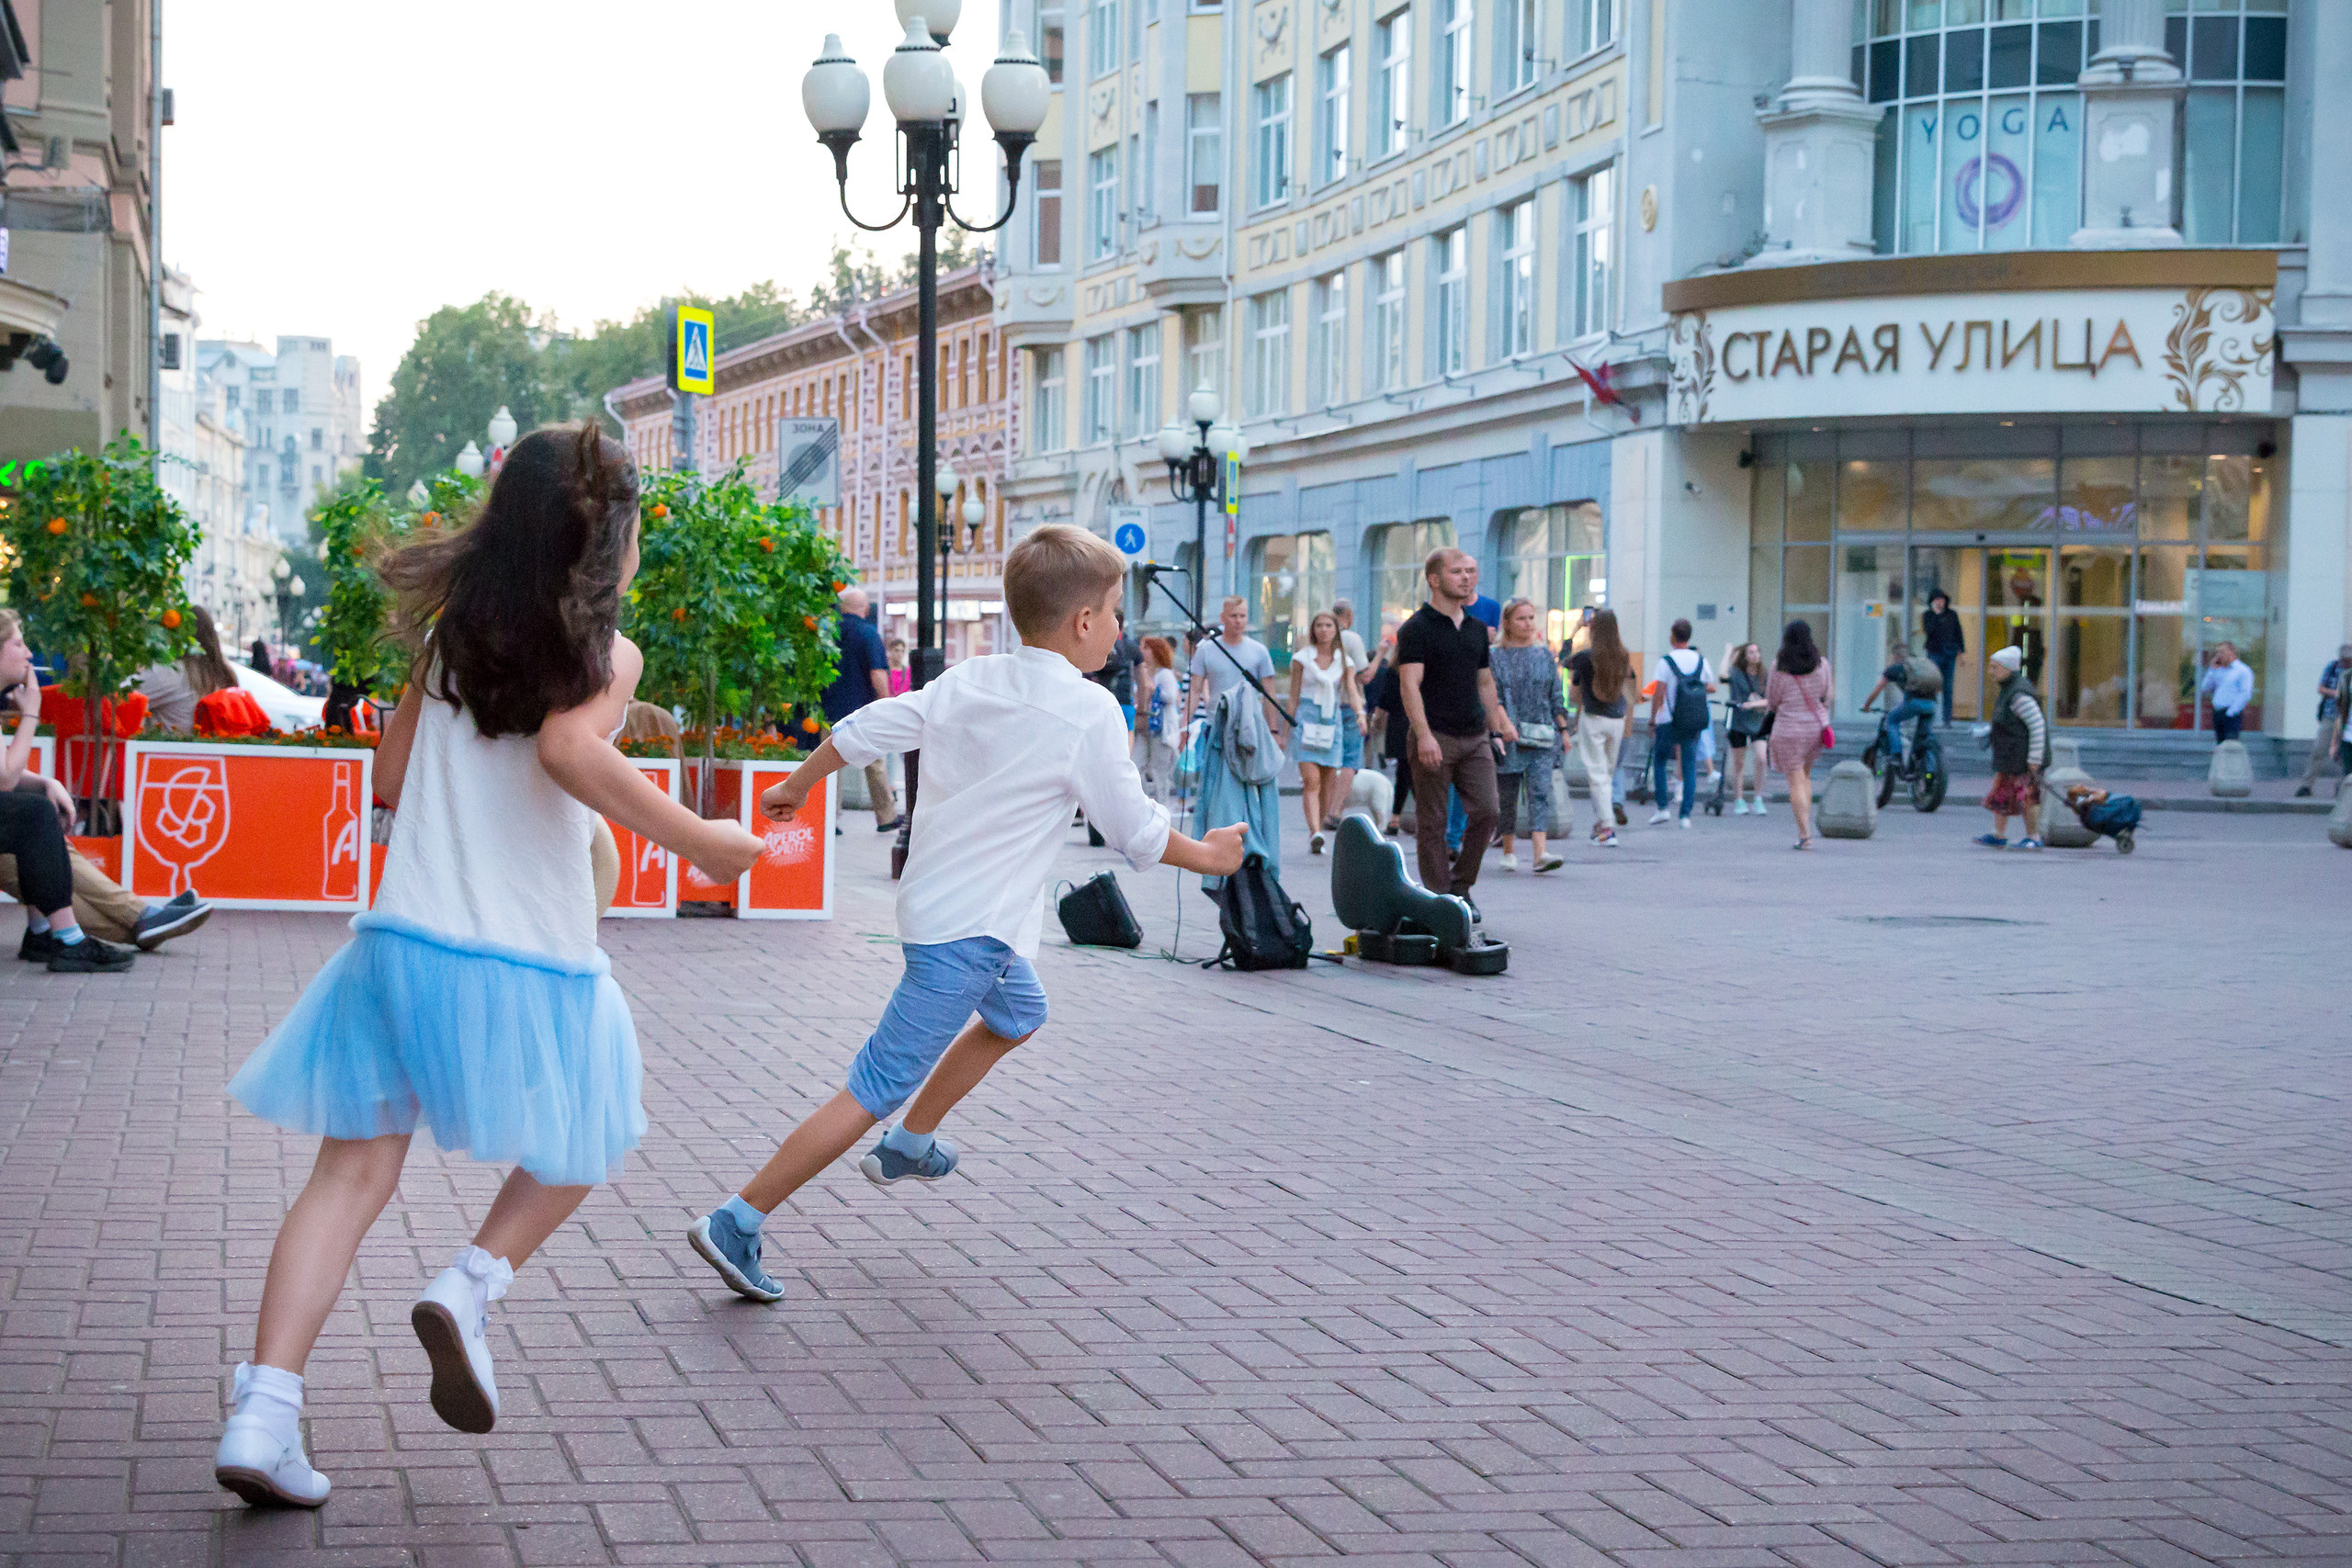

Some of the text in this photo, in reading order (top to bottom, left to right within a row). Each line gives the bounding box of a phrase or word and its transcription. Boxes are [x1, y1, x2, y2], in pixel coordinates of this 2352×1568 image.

[1921, 106, 2069, 144] YOGA
[1722, 318, 2143, 382] СТАРАЯ УЛИЦА
[793, 423, 824, 434] ЗОНА
[764, 827, 814, 850] APEROL
